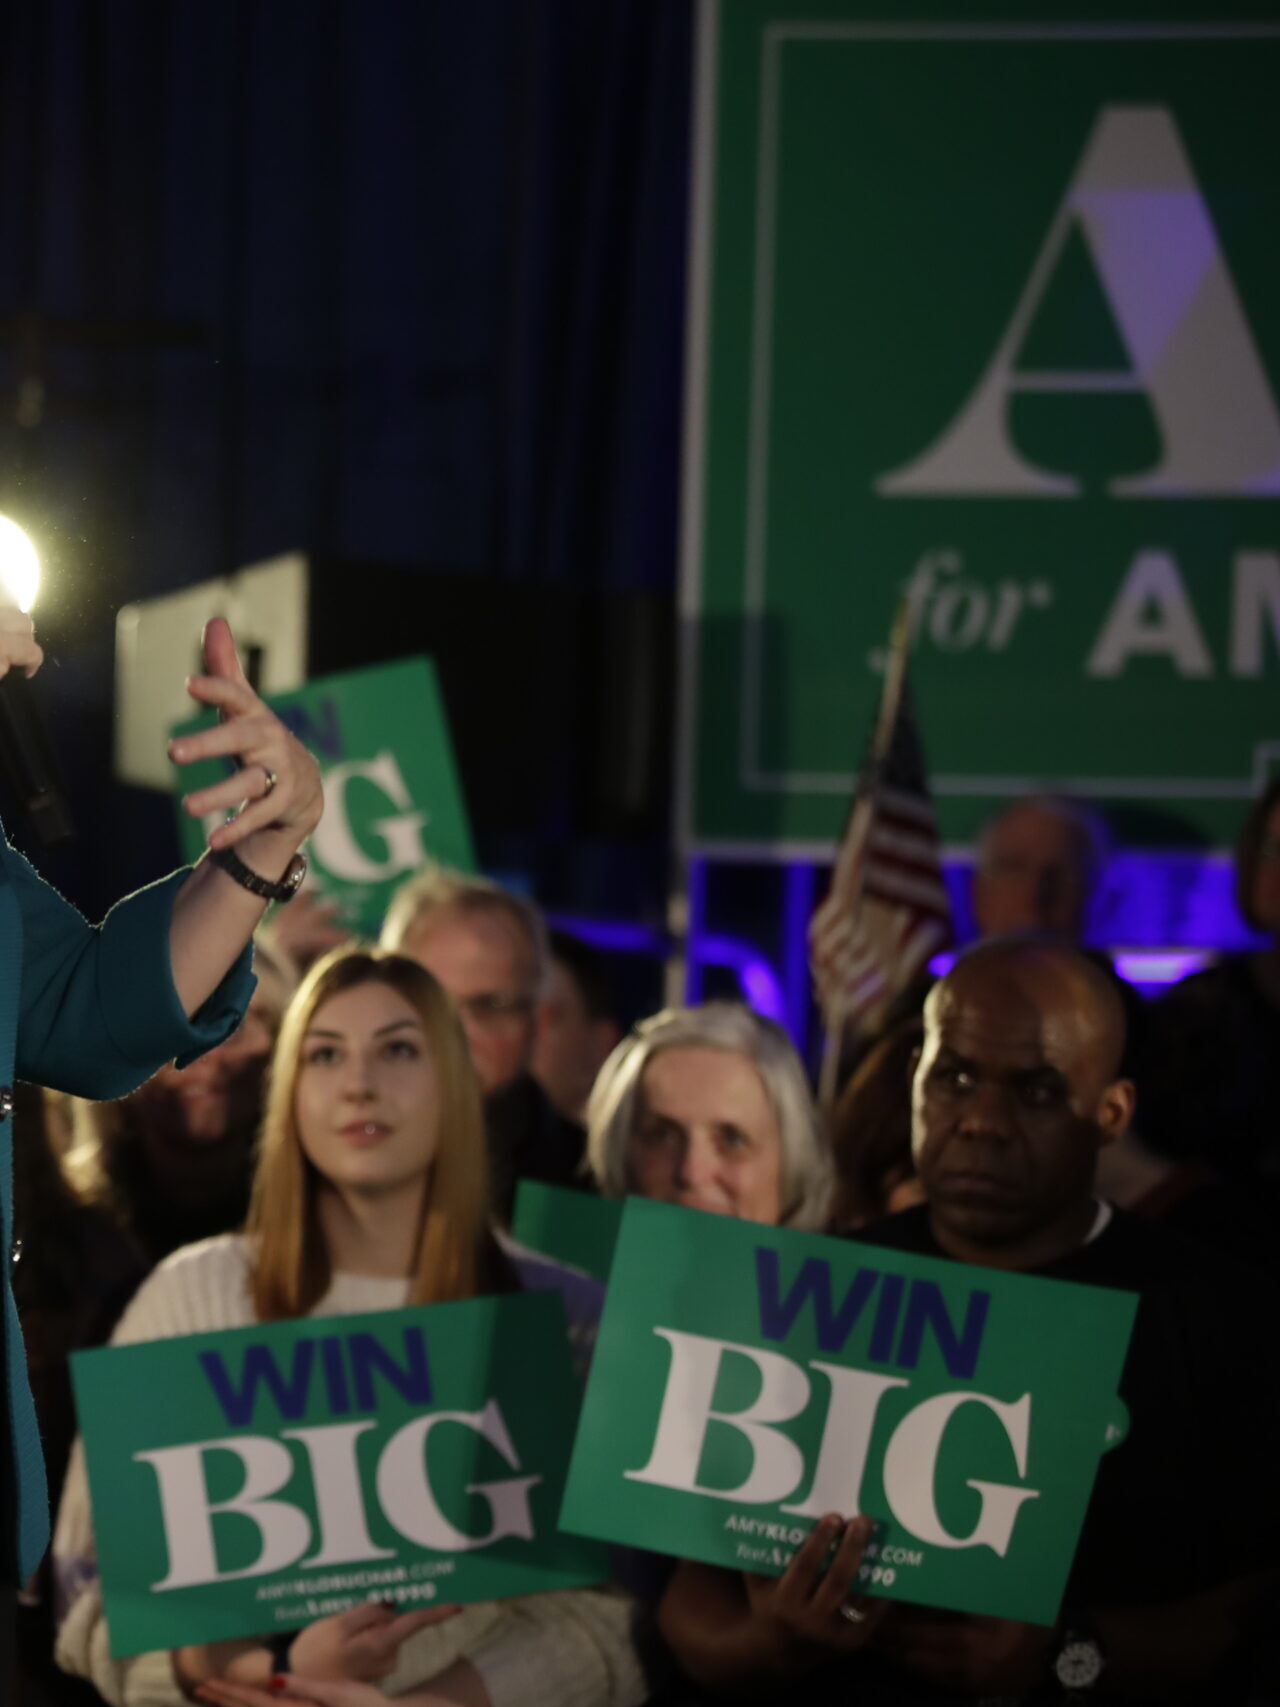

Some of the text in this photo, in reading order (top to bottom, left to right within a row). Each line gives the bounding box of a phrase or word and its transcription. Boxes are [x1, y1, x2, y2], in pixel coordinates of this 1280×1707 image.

[869, 547, 1053, 674] for
[198, 1326, 434, 1428] WIN
[755, 1246, 991, 1380] WIN
[133, 1399, 543, 1593] BIG
[623, 1326, 1041, 1558] BIG
